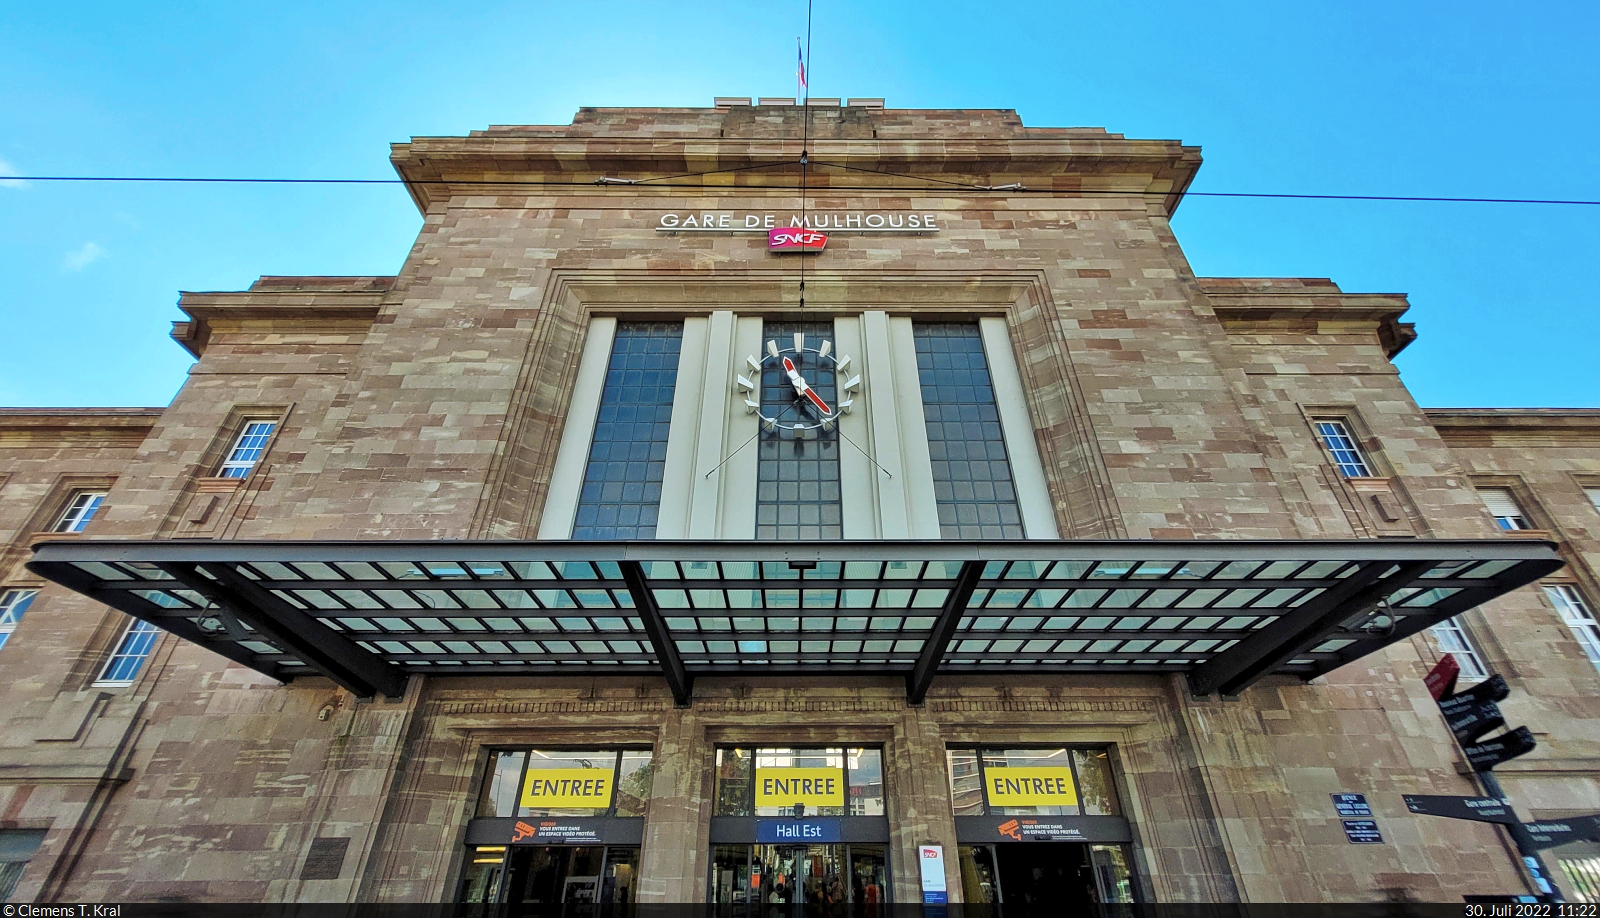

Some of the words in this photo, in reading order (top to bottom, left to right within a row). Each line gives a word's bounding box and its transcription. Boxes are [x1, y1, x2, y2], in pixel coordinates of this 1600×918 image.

[660, 213, 730, 227] GARE
[745, 214, 775, 228] DE
[789, 214, 937, 228] MULHOUSE
[771, 233, 824, 246] SNCF
[530, 779, 605, 796] ENTREE
[763, 778, 835, 795] ENTREE
[993, 777, 1067, 795] ENTREE
[776, 824, 800, 837] Hall
[803, 824, 822, 837] Est
